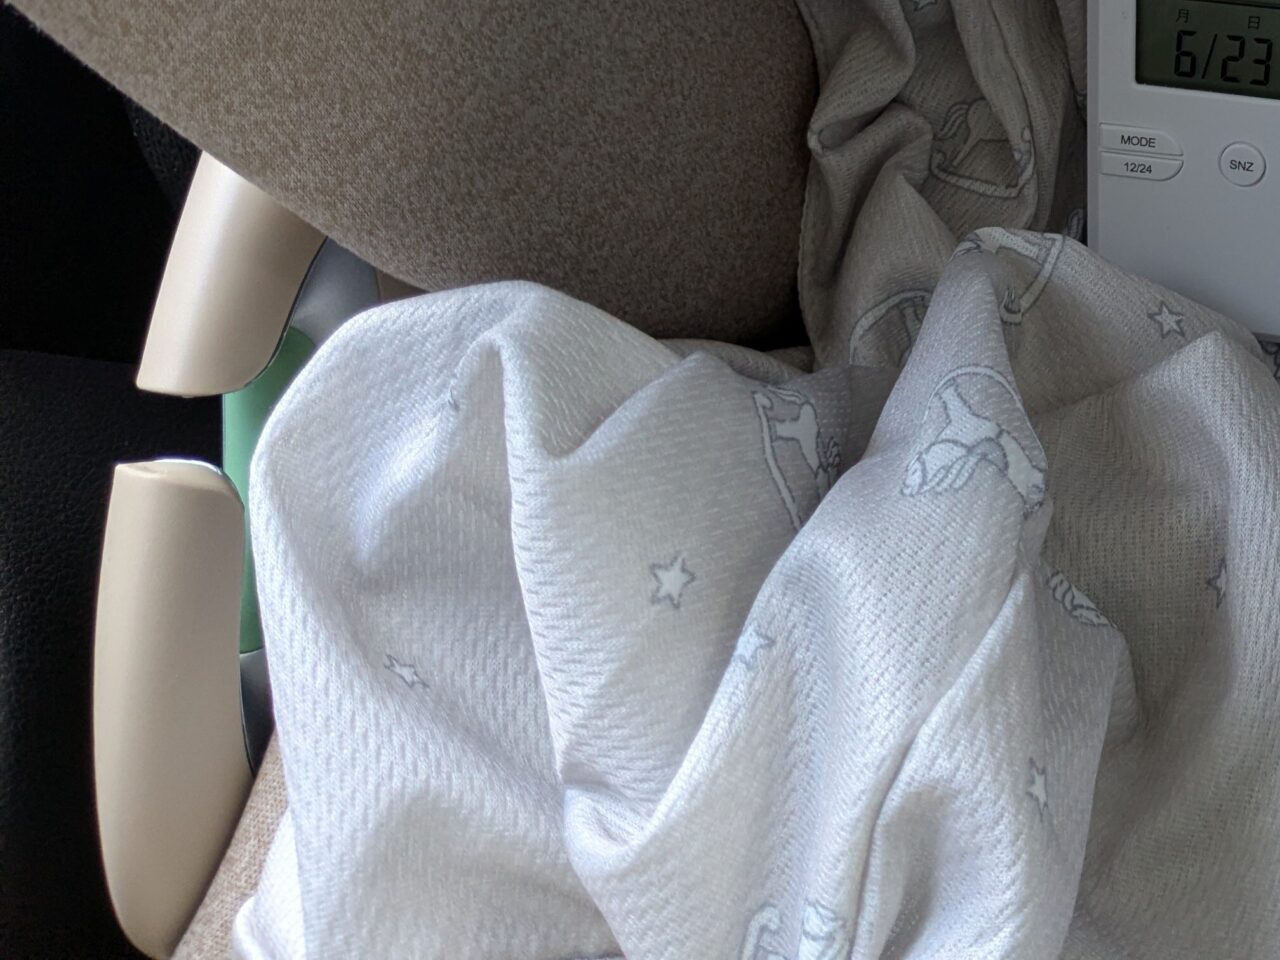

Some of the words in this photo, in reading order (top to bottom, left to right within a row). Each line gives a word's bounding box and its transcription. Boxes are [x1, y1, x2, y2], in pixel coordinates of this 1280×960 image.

[1175, 8, 1190, 24] 月
[1247, 15, 1261, 30] 日
[1173, 29, 1274, 87] 6/23
[1120, 134, 1156, 149] MODE
[1123, 161, 1153, 175] 12/24
[1229, 159, 1254, 173] SNZ
